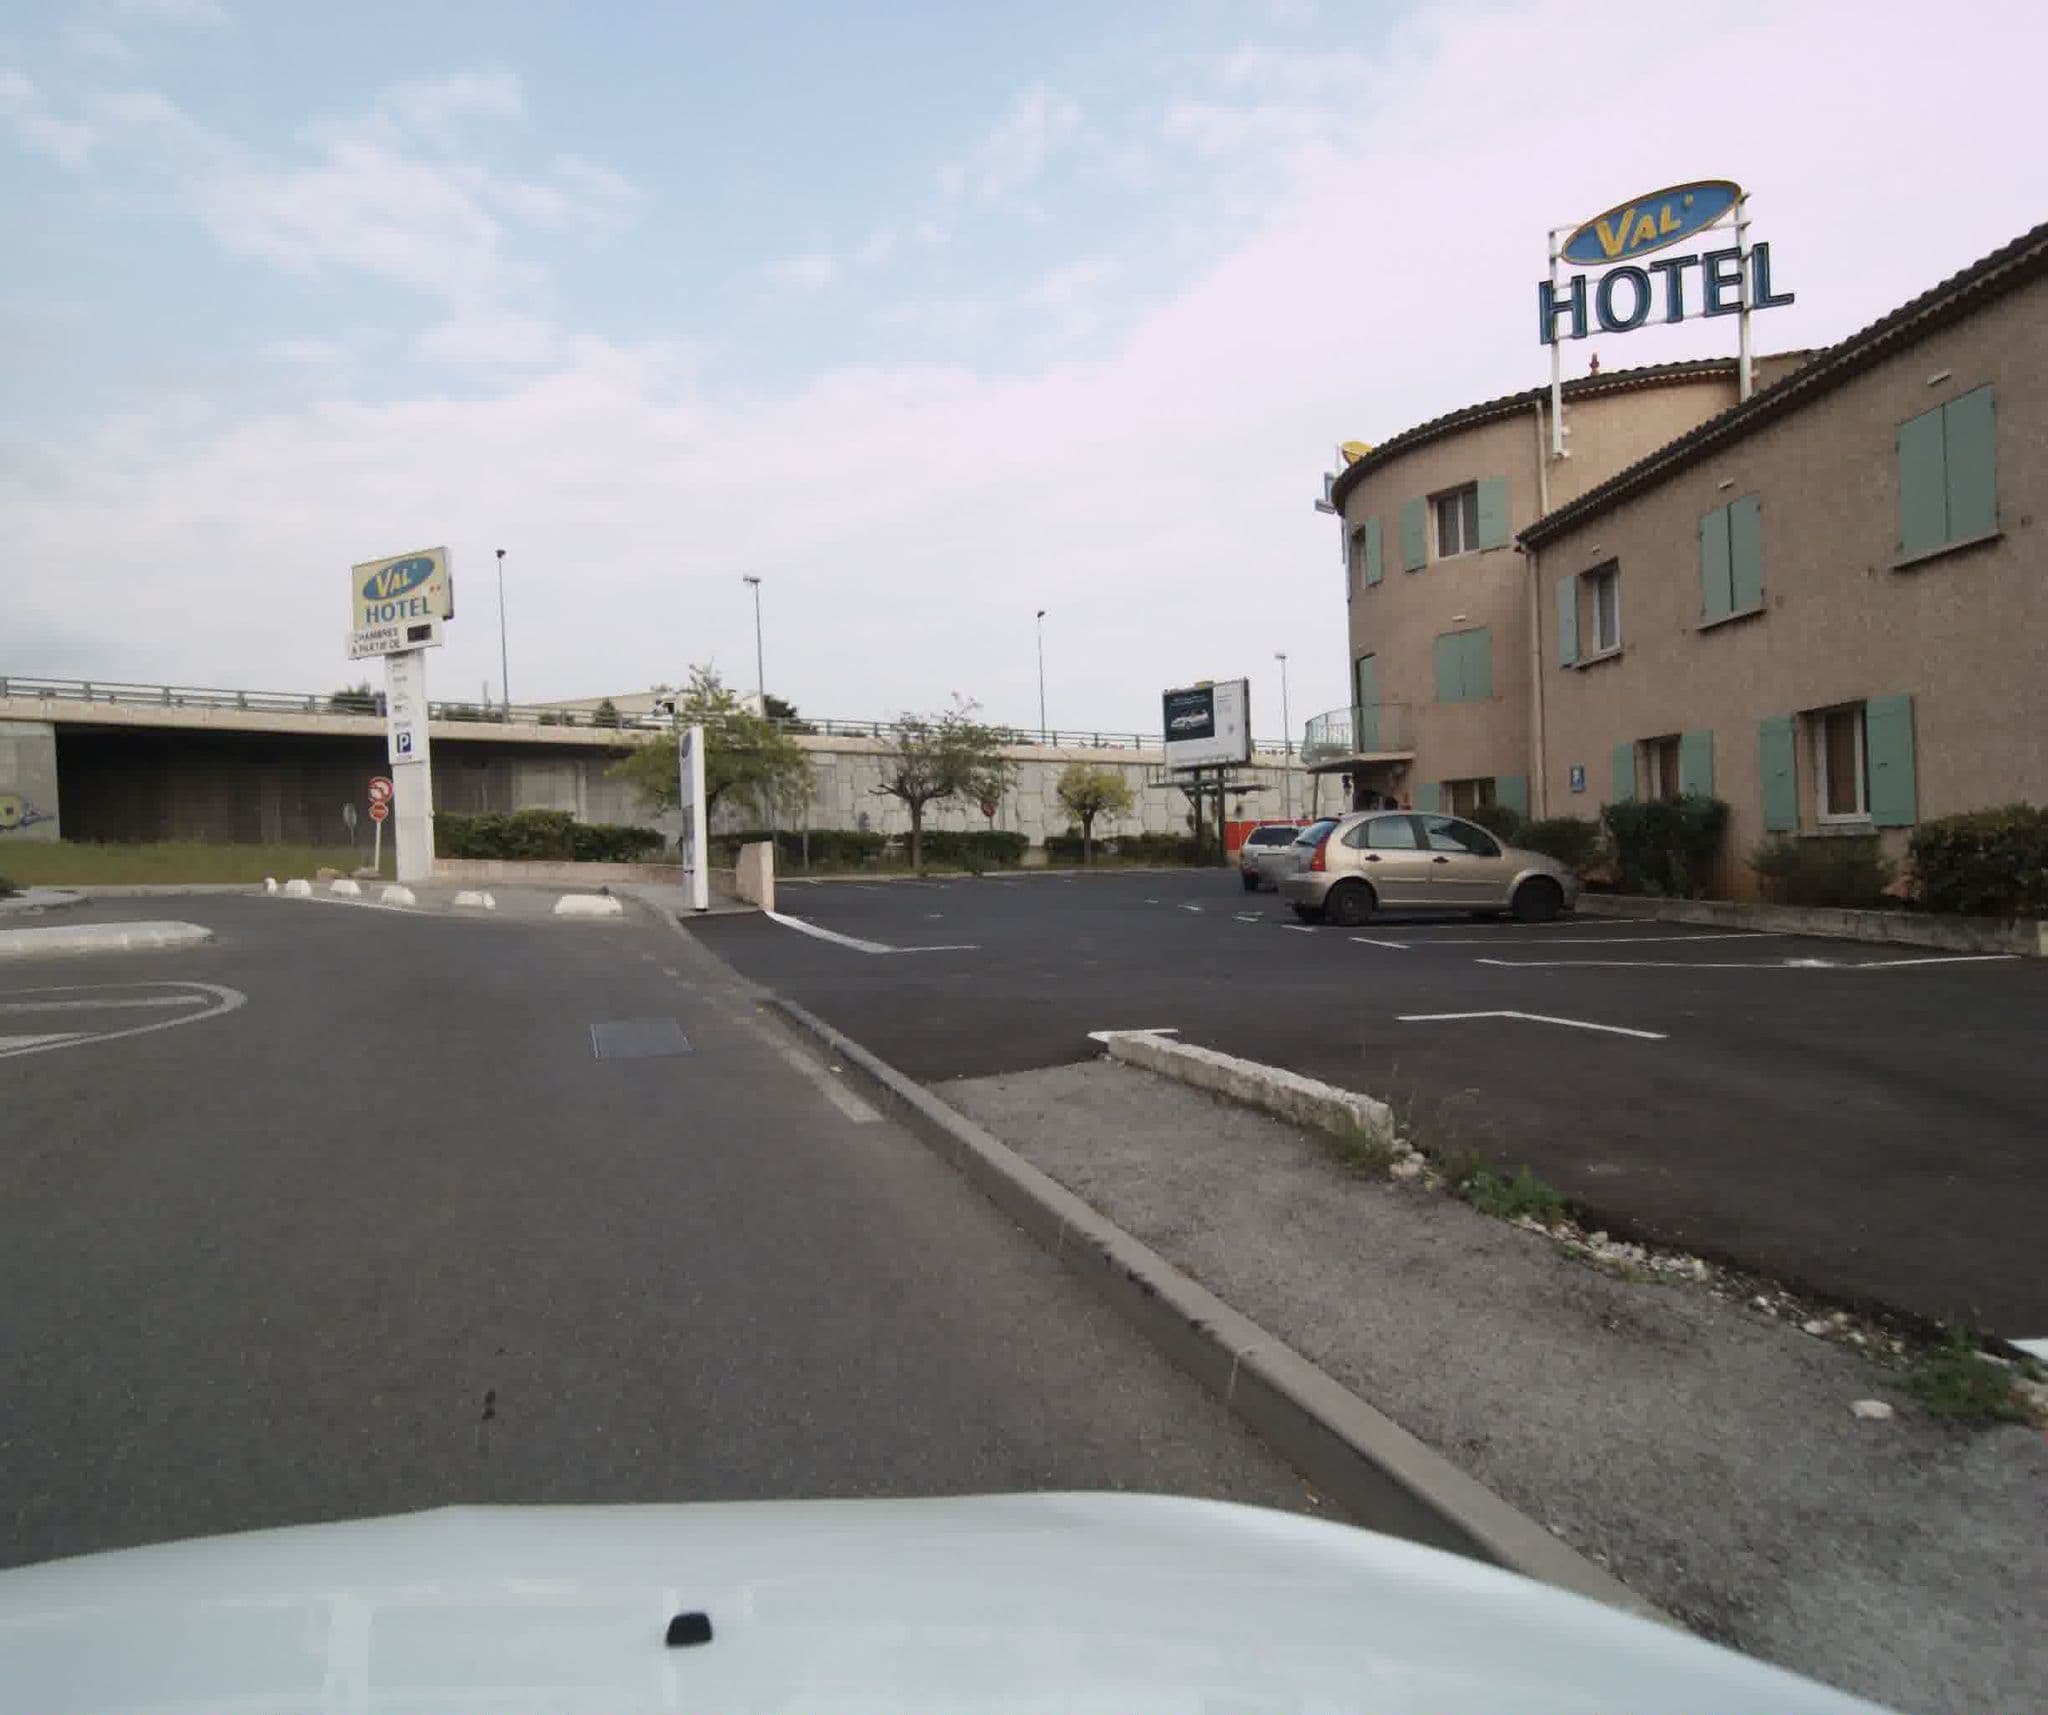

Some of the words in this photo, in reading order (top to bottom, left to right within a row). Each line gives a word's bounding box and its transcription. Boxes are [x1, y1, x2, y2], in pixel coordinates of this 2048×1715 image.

[1539, 241, 1795, 345] HOTEL
[366, 596, 432, 624] HOTEL
[399, 733, 410, 752] P
